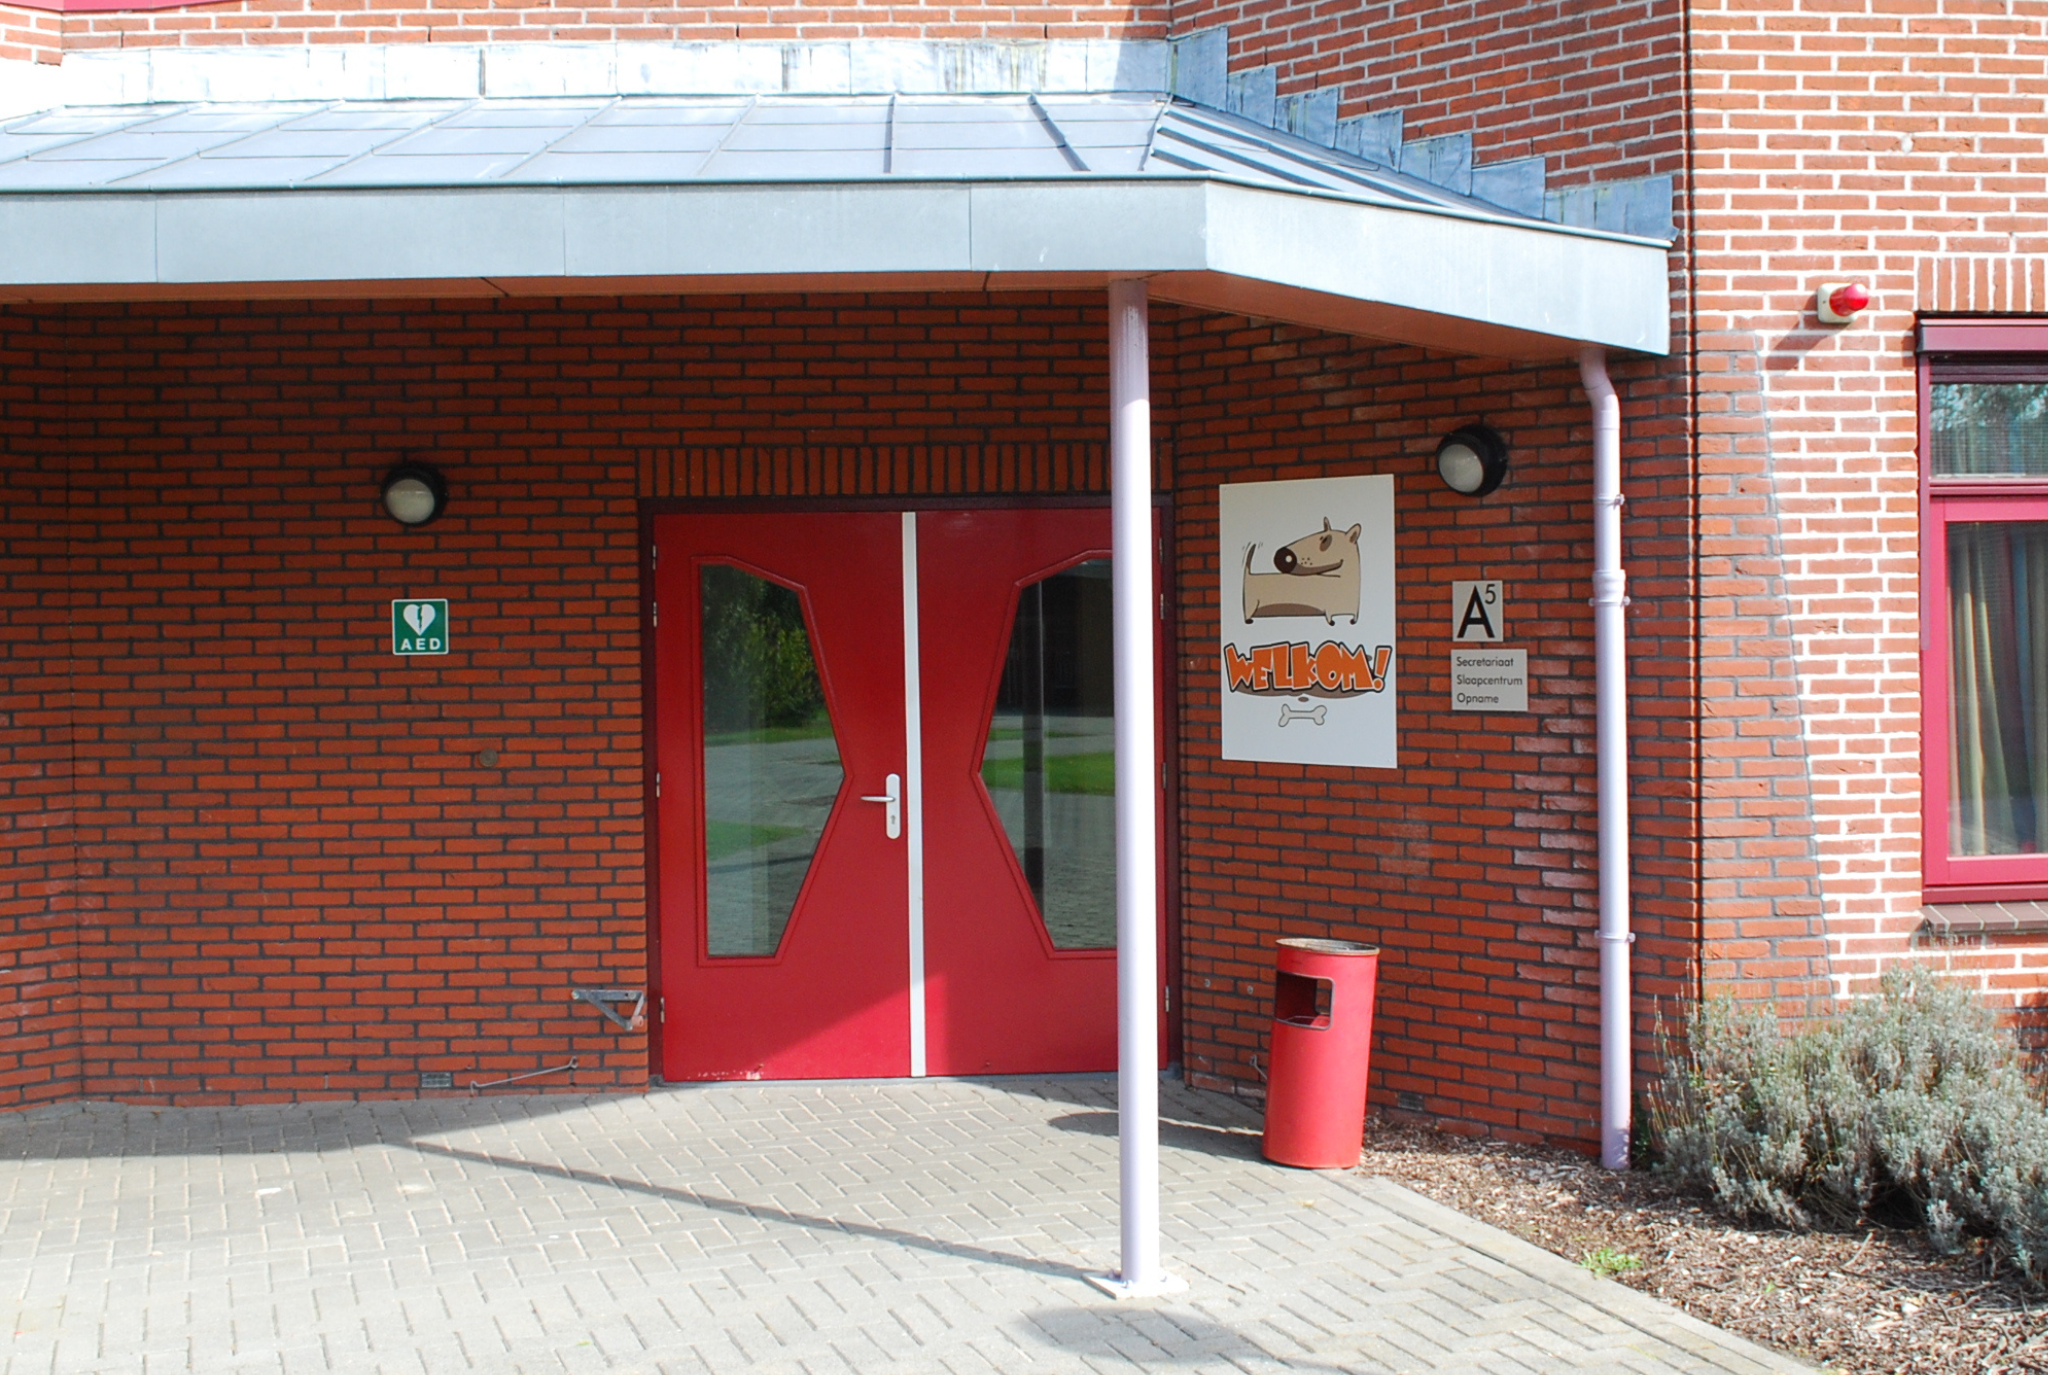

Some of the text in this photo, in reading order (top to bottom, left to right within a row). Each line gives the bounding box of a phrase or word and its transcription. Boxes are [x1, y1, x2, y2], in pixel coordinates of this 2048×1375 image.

[400, 637, 441, 651] AED
[1456, 656, 1514, 668] Secretariaat
[1456, 674, 1523, 687] Slaapcentrum
[1456, 692, 1500, 705] Opname
